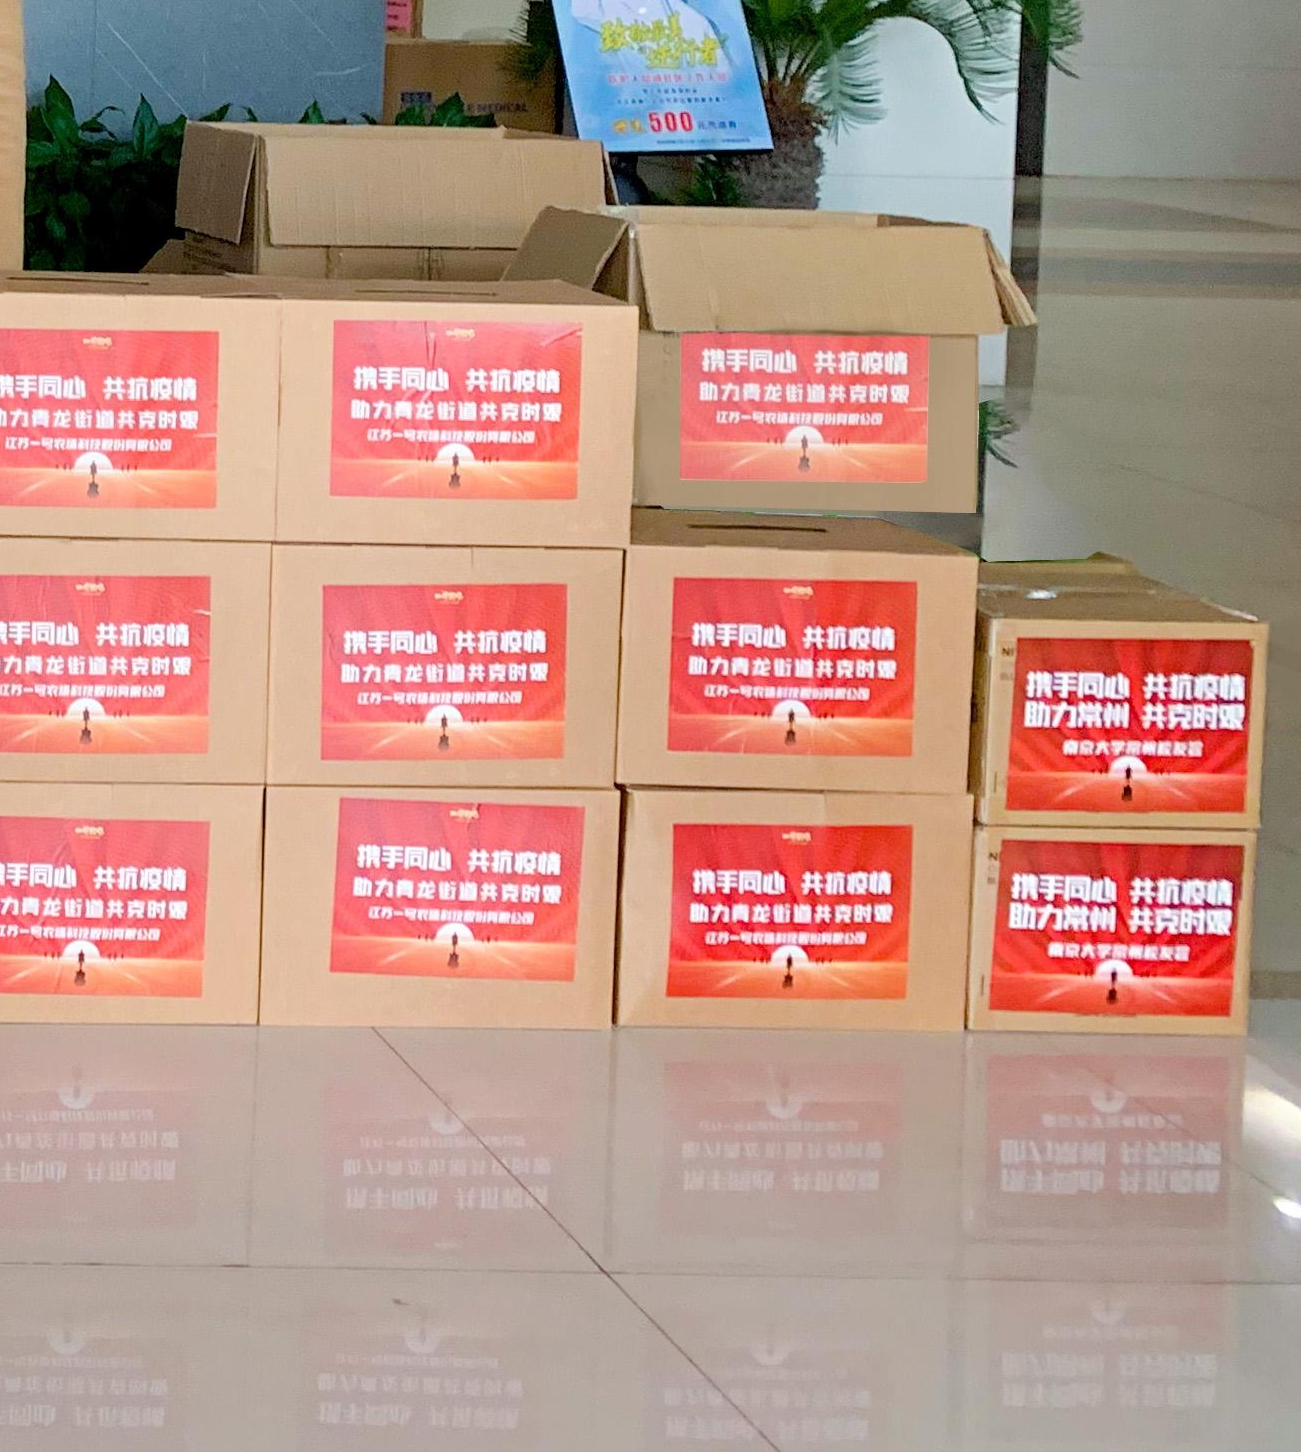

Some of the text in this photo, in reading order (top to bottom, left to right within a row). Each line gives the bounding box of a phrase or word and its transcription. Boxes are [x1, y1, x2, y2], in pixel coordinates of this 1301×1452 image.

[648, 110, 694, 133] 500
[701, 348, 908, 374] 携手同心 共抗疫情
[103, 377, 197, 400] 共抗疫情
[353, 366, 560, 393] 携手同心 共抗疫情
[96, 623, 189, 646] 共抗疫情
[343, 629, 546, 654] 携手同心 共抗疫情
[691, 623, 895, 650] 携手同心 共抗疫情
[1026, 671, 1245, 700] 携手同心 共抗疫情
[1024, 701, 1245, 730] 助力常州 共克时艰
[357, 844, 561, 875] 携手同心 共抗疫情
[93, 866, 186, 891] 共抗疫情
[693, 869, 891, 895] 携手同心 共抗疫情
[1011, 874, 1233, 905] 携手同心 共抗疫情
[1008, 902, 1232, 935] 助力常州 共克时艰
